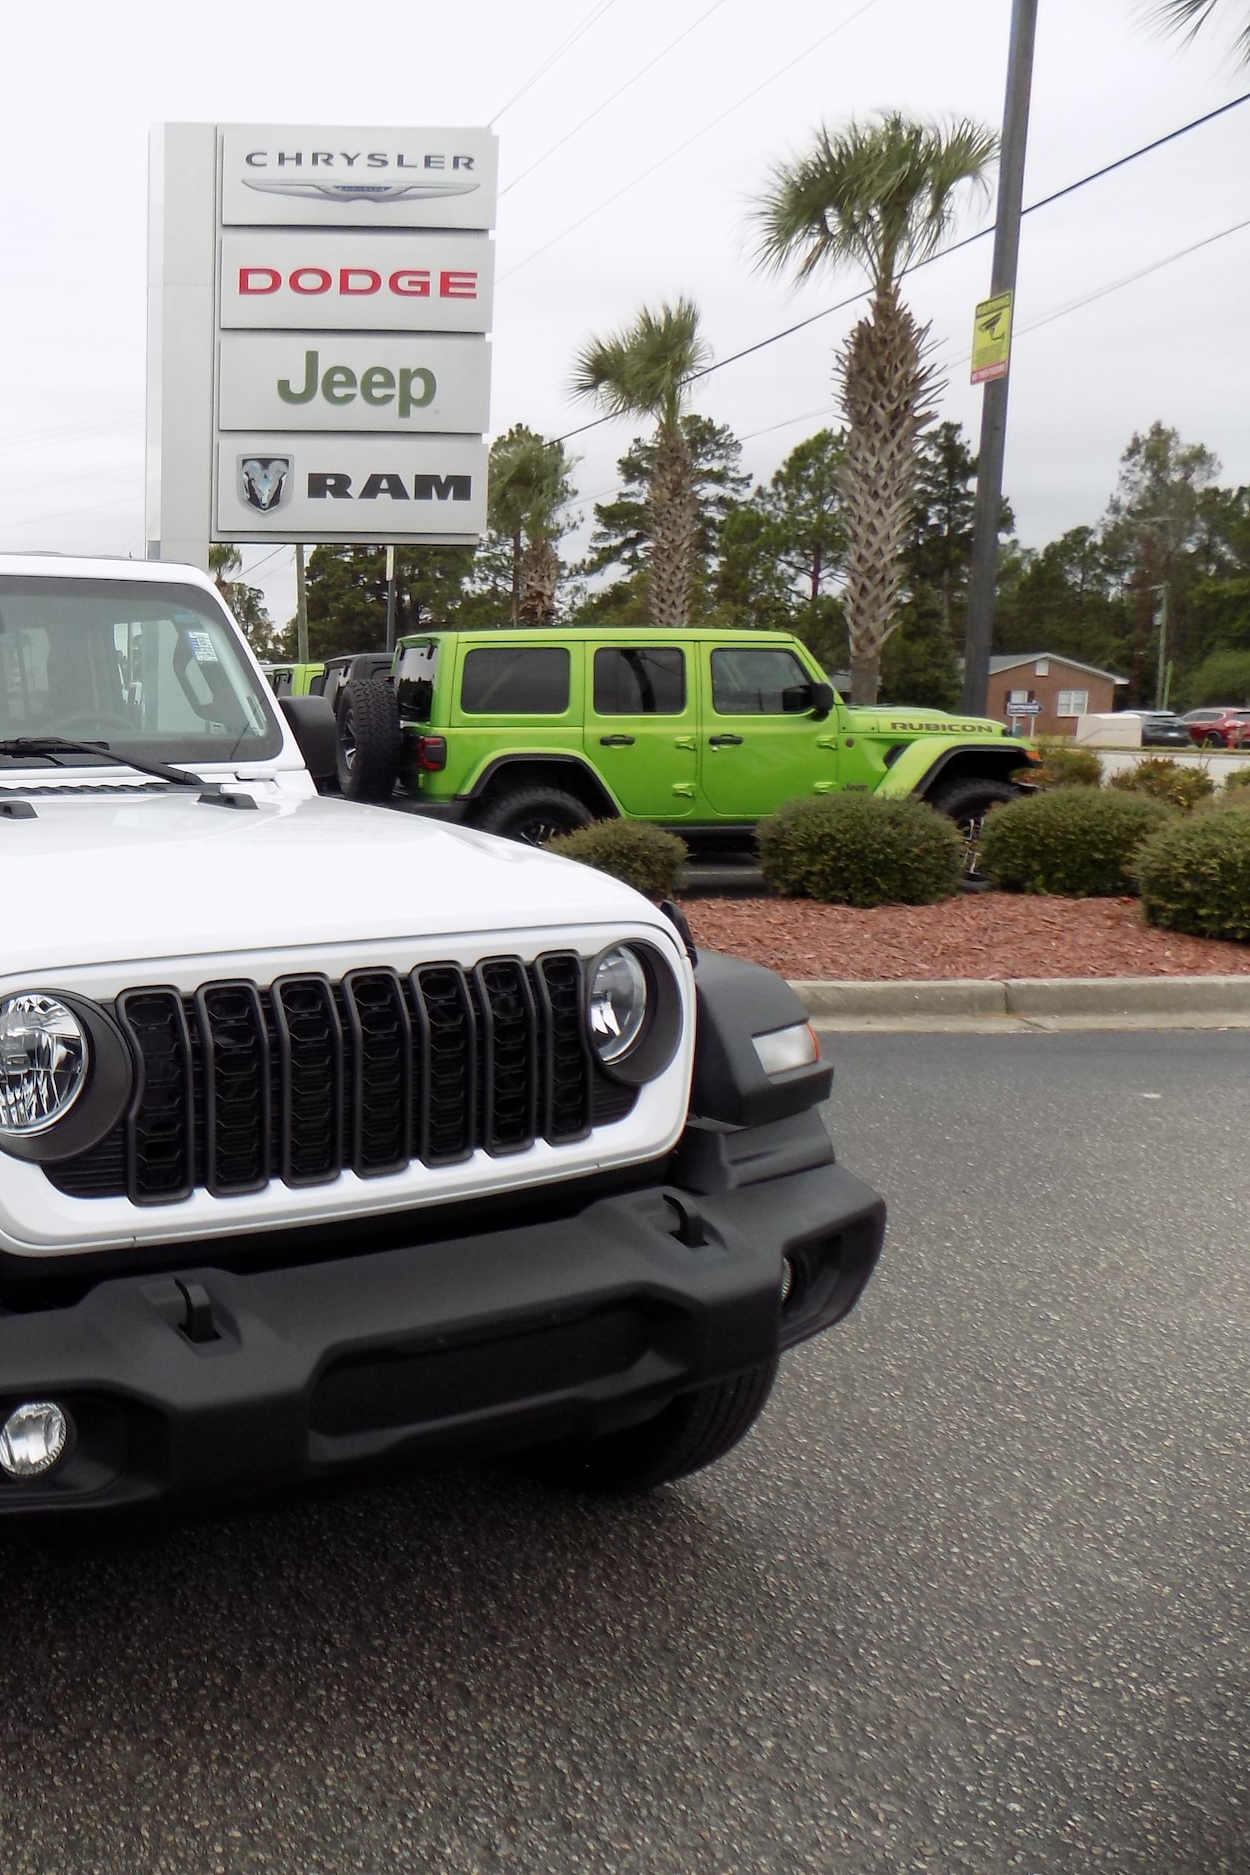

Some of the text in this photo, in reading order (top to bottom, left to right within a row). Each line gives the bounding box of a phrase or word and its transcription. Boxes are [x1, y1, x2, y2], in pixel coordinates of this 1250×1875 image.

[245, 151, 476, 171] CHRYSLER
[238, 267, 478, 299] DODGE
[276, 350, 437, 419] Jeep
[307, 472, 472, 502] RAM
[890, 721, 993, 732] RUBICON
